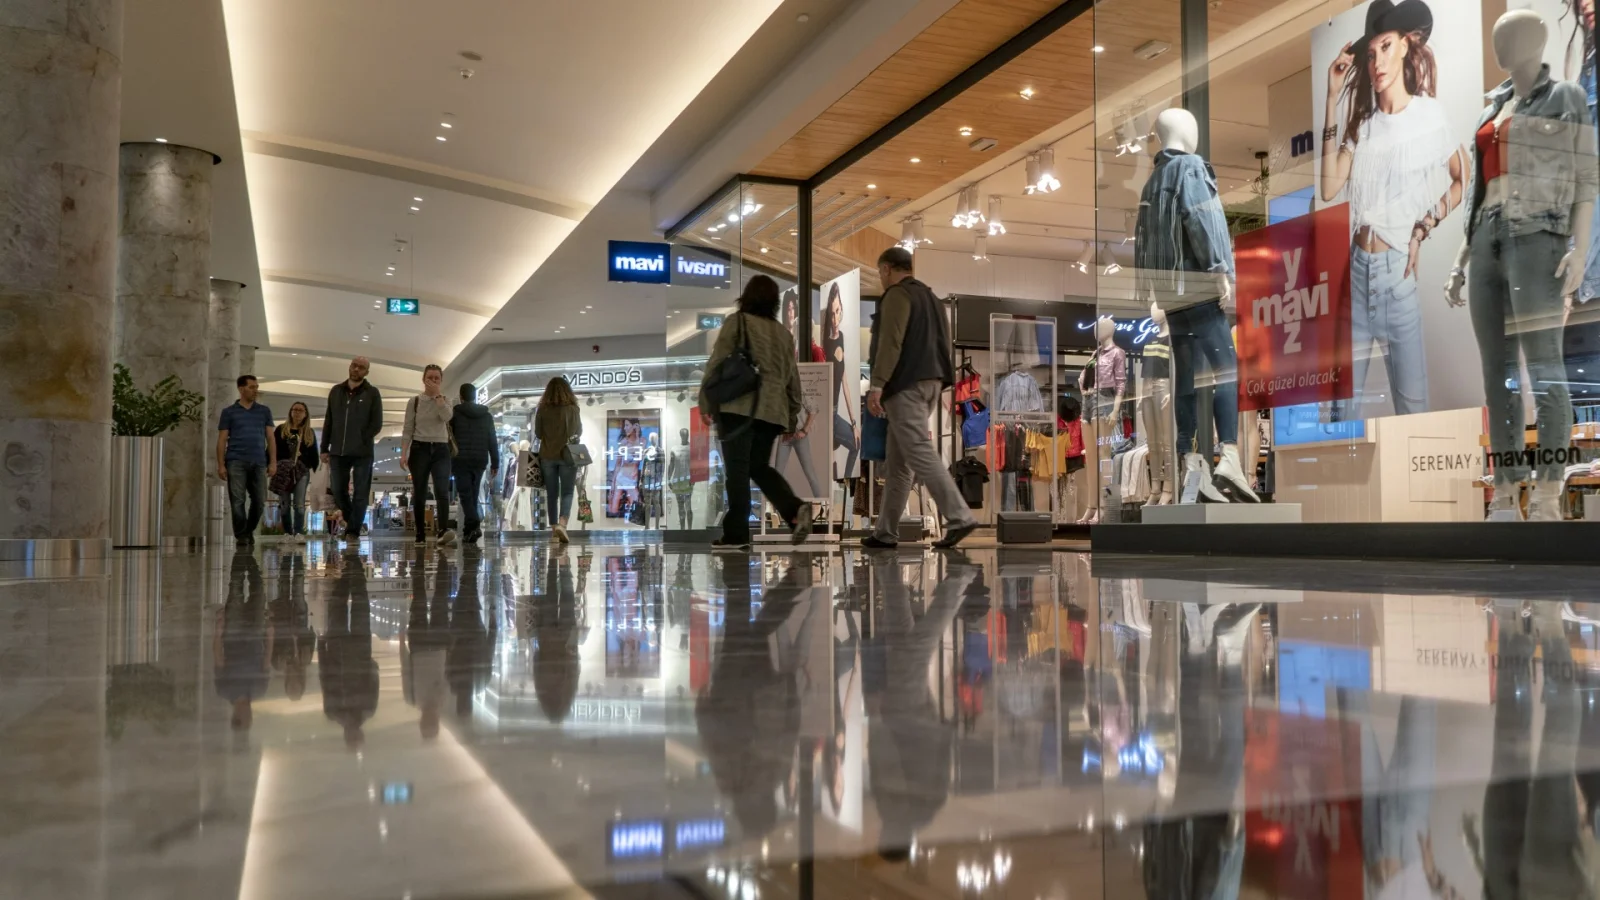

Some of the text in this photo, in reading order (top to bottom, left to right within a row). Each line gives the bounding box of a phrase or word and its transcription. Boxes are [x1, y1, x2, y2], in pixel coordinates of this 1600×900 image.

[615, 254, 664, 272] mavi
[1252, 271, 1329, 329] mavi
[1133, 317, 1160, 344] Go
[562, 366, 641, 387] MENDO'S
[1268, 373, 1296, 395] güzel
[1411, 453, 1472, 472] SERENAY
